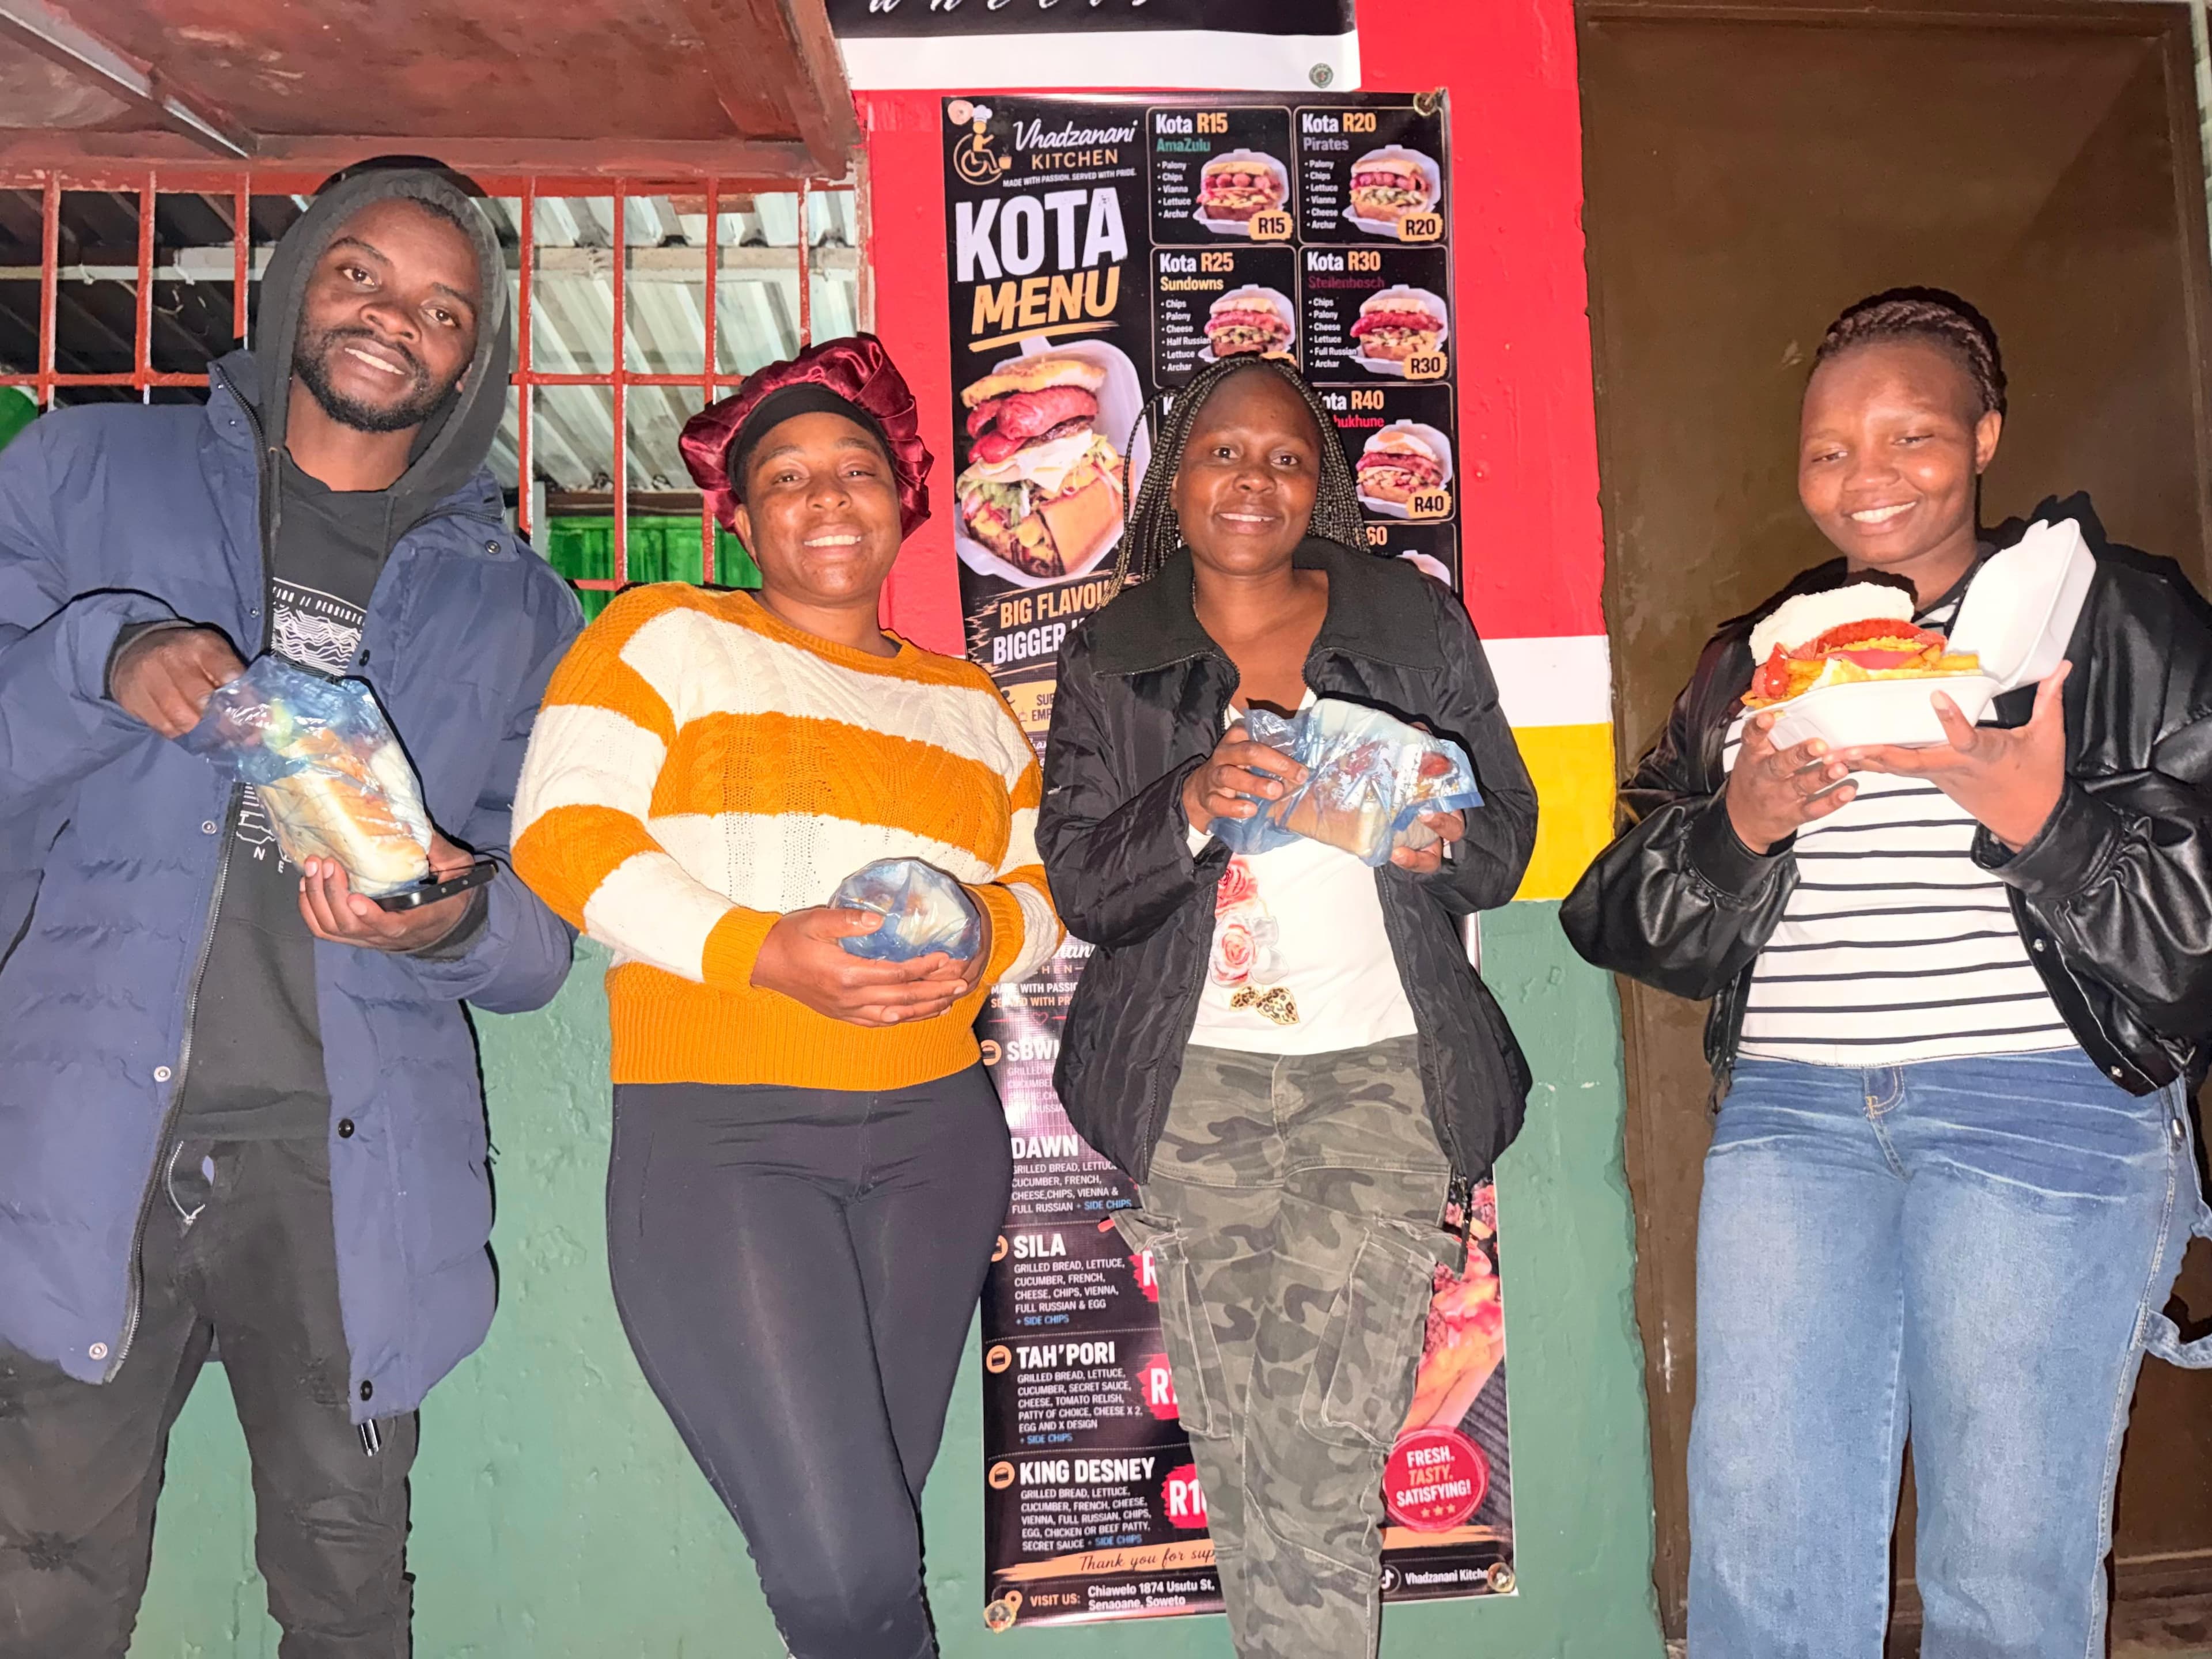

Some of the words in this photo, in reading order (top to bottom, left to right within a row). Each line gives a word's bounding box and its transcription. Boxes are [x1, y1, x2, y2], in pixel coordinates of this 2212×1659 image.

[1156, 114, 1193, 134] Kota
[1196, 113, 1228, 133] R15
[1302, 114, 1339, 133] Kota
[1343, 113, 1376, 132] R20
[1013, 119, 1138, 151] Vhadzanani
[1157, 138, 1211, 152] AmaZulu
[1303, 137, 1349, 151] Pirates
[1031, 149, 1119, 170] KITCHEN
[1162, 161, 1187, 171] Palony
[1309, 160, 1334, 169] Palony
[1003, 177, 1022, 187] MADE
[1024, 175, 1041, 185] WITH
[1072, 171, 1097, 181] SERVED
[1098, 169, 1115, 179] WITH
[1162, 173, 1183, 183] Chips
[1310, 172, 1331, 181] Chips
[1310, 184, 1338, 192] Lettuce
[1163, 198, 1191, 206] Lettuce
[1163, 210, 1188, 218] Archar
[1311, 209, 1338, 217] Cheese
[1258, 217, 1285, 234] R15
[1311, 221, 1336, 229] Archar
[1406, 219, 1435, 236] R20
[955, 187, 1128, 282] KOTA
[1160, 253, 1196, 272] Kota
[1201, 252, 1234, 272] R25
[1307, 252, 1344, 271] Kota
[1348, 251, 1381, 271] R30
[1160, 276, 1224, 291] Sundowns
[971, 266, 1120, 335] MENU
[1165, 300, 1187, 309] Chips
[1313, 298, 1334, 308] Chips
[1166, 312, 1191, 321] Palony
[1313, 310, 1338, 320] Palony
[1166, 324, 1194, 333] Cheese
[1314, 323, 1341, 331] Cheese
[1166, 337, 1181, 346] Half
[1183, 336, 1211, 345] Russian
[1315, 335, 1342, 343] Lettuce
[1166, 350, 1195, 359] Lettuce
[1315, 347, 1328, 355] Full
[1329, 347, 1357, 355] Russian
[1167, 363, 1192, 372] Archar
[1315, 360, 1340, 368] Archar
[1411, 357, 1440, 374] R30
[1318, 392, 1347, 410] ota
[1351, 390, 1384, 410] R40
[1333, 414, 1385, 428] hukhune
[1414, 495, 1444, 513] R40
[1000, 597, 1032, 629] BIG
[993, 623, 1066, 665] BIGGER
[1020, 983, 1044, 994] WITH
[1031, 997, 1055, 1006] WITH
[1011, 1134, 1078, 1160] DAWN
[1048, 1162, 1080, 1173] BREAD,
[1082, 1161, 1118, 1172] LETTUC
[1012, 1176, 1062, 1188] CUCUMBER,
[1065, 1175, 1102, 1185] FRENCH,
[1077, 1187, 1109, 1198] VIENNA
[1111, 1186, 1119, 1196] &
[1012, 1204, 1033, 1214] FULL
[1036, 1202, 1073, 1213] RUSSIAN
[1084, 1199, 1104, 1210] SIDE
[1105, 1198, 1132, 1209] CHIPS
[1013, 1233, 1066, 1259] SILA
[1014, 1262, 1050, 1274] GRILLED
[1052, 1260, 1084, 1271] BREAD,
[1086, 1258, 1125, 1270] LETTUCE,
[1014, 1275, 1066, 1287] CUCUMBER,
[1068, 1272, 1105, 1284] FRENCH,
[1053, 1287, 1082, 1298] CHIPS,
[1084, 1285, 1119, 1296] VIENNA,
[1015, 1302, 1037, 1314] FULL
[1039, 1301, 1076, 1312] RUSSIAN
[1078, 1300, 1086, 1309] &
[1088, 1298, 1106, 1309] EGG
[1024, 1315, 1043, 1326] SIDE
[1044, 1314, 1070, 1325] CHIPS
[1017, 1372, 1052, 1384] GRILLED
[1054, 1370, 1086, 1381] BREAD,
[1087, 1368, 1126, 1379] LETTUCE,
[1017, 1384, 1067, 1396] CUCUMBER,
[1069, 1382, 1100, 1393] SECRET
[1101, 1380, 1132, 1392] SAUCE,
[1018, 1397, 1053, 1409] CHEESE,
[1055, 1395, 1090, 1406] TOMATO
[1018, 1410, 1043, 1421] PATTY
[1046, 1408, 1056, 1419] OF
[1059, 1407, 1092, 1418] CHOICE,
[1093, 1406, 1125, 1416] CHEESE
[1127, 1406, 1133, 1415] X
[1018, 1422, 1036, 1433] EGG
[1038, 1421, 1056, 1431] AND
[1059, 1421, 1065, 1430] X
[1066, 1419, 1098, 1430] DESIGN
[1027, 1434, 1046, 1444] SIDE
[1048, 1432, 1073, 1443] CHIPS
[1406, 1445, 1455, 1468] FRESH.
[1020, 1459, 1070, 1486] KING
[1074, 1457, 1156, 1484] DESNEY
[1408, 1464, 1453, 1486] TASTY.
[1020, 1488, 1056, 1500] GRILLED
[1058, 1488, 1089, 1499] BREAD,
[1092, 1486, 1131, 1498] LETTUCE,
[1396, 1479, 1472, 1508] SATISFYING!
[1021, 1501, 1071, 1513] CUCUMBER,
[1073, 1501, 1110, 1511] FRENCH,
[1112, 1497, 1147, 1508] CHEESE,
[1021, 1514, 1056, 1525] VIENNA,
[1058, 1514, 1079, 1525] FULL
[1123, 1508, 1152, 1520] CHIPS,
[1022, 1528, 1043, 1539] EGG,
[1044, 1527, 1082, 1538] CHICKEN
[1084, 1527, 1097, 1536] OR
[1099, 1523, 1120, 1535] BEEF
[1122, 1521, 1151, 1532] PATTY,
[1022, 1540, 1054, 1551] SECRET
[1056, 1539, 1085, 1551] SAUCE
[1094, 1536, 1114, 1546] SIDE
[1116, 1533, 1142, 1544] CHIPS
[1080, 1552, 1124, 1571] Thank
[1130, 1555, 1157, 1571] you
[1161, 1547, 1185, 1570] for
[1404, 1569, 1458, 1585] Vhadzanani
[1088, 1583, 1137, 1598] Chiawelo
[1139, 1581, 1164, 1594] 1874
[1166, 1580, 1198, 1593] Usutu
[1030, 1595, 1059, 1607] VISIT
[1061, 1594, 1081, 1607] US:
[1145, 1595, 1185, 1607] Soweto
